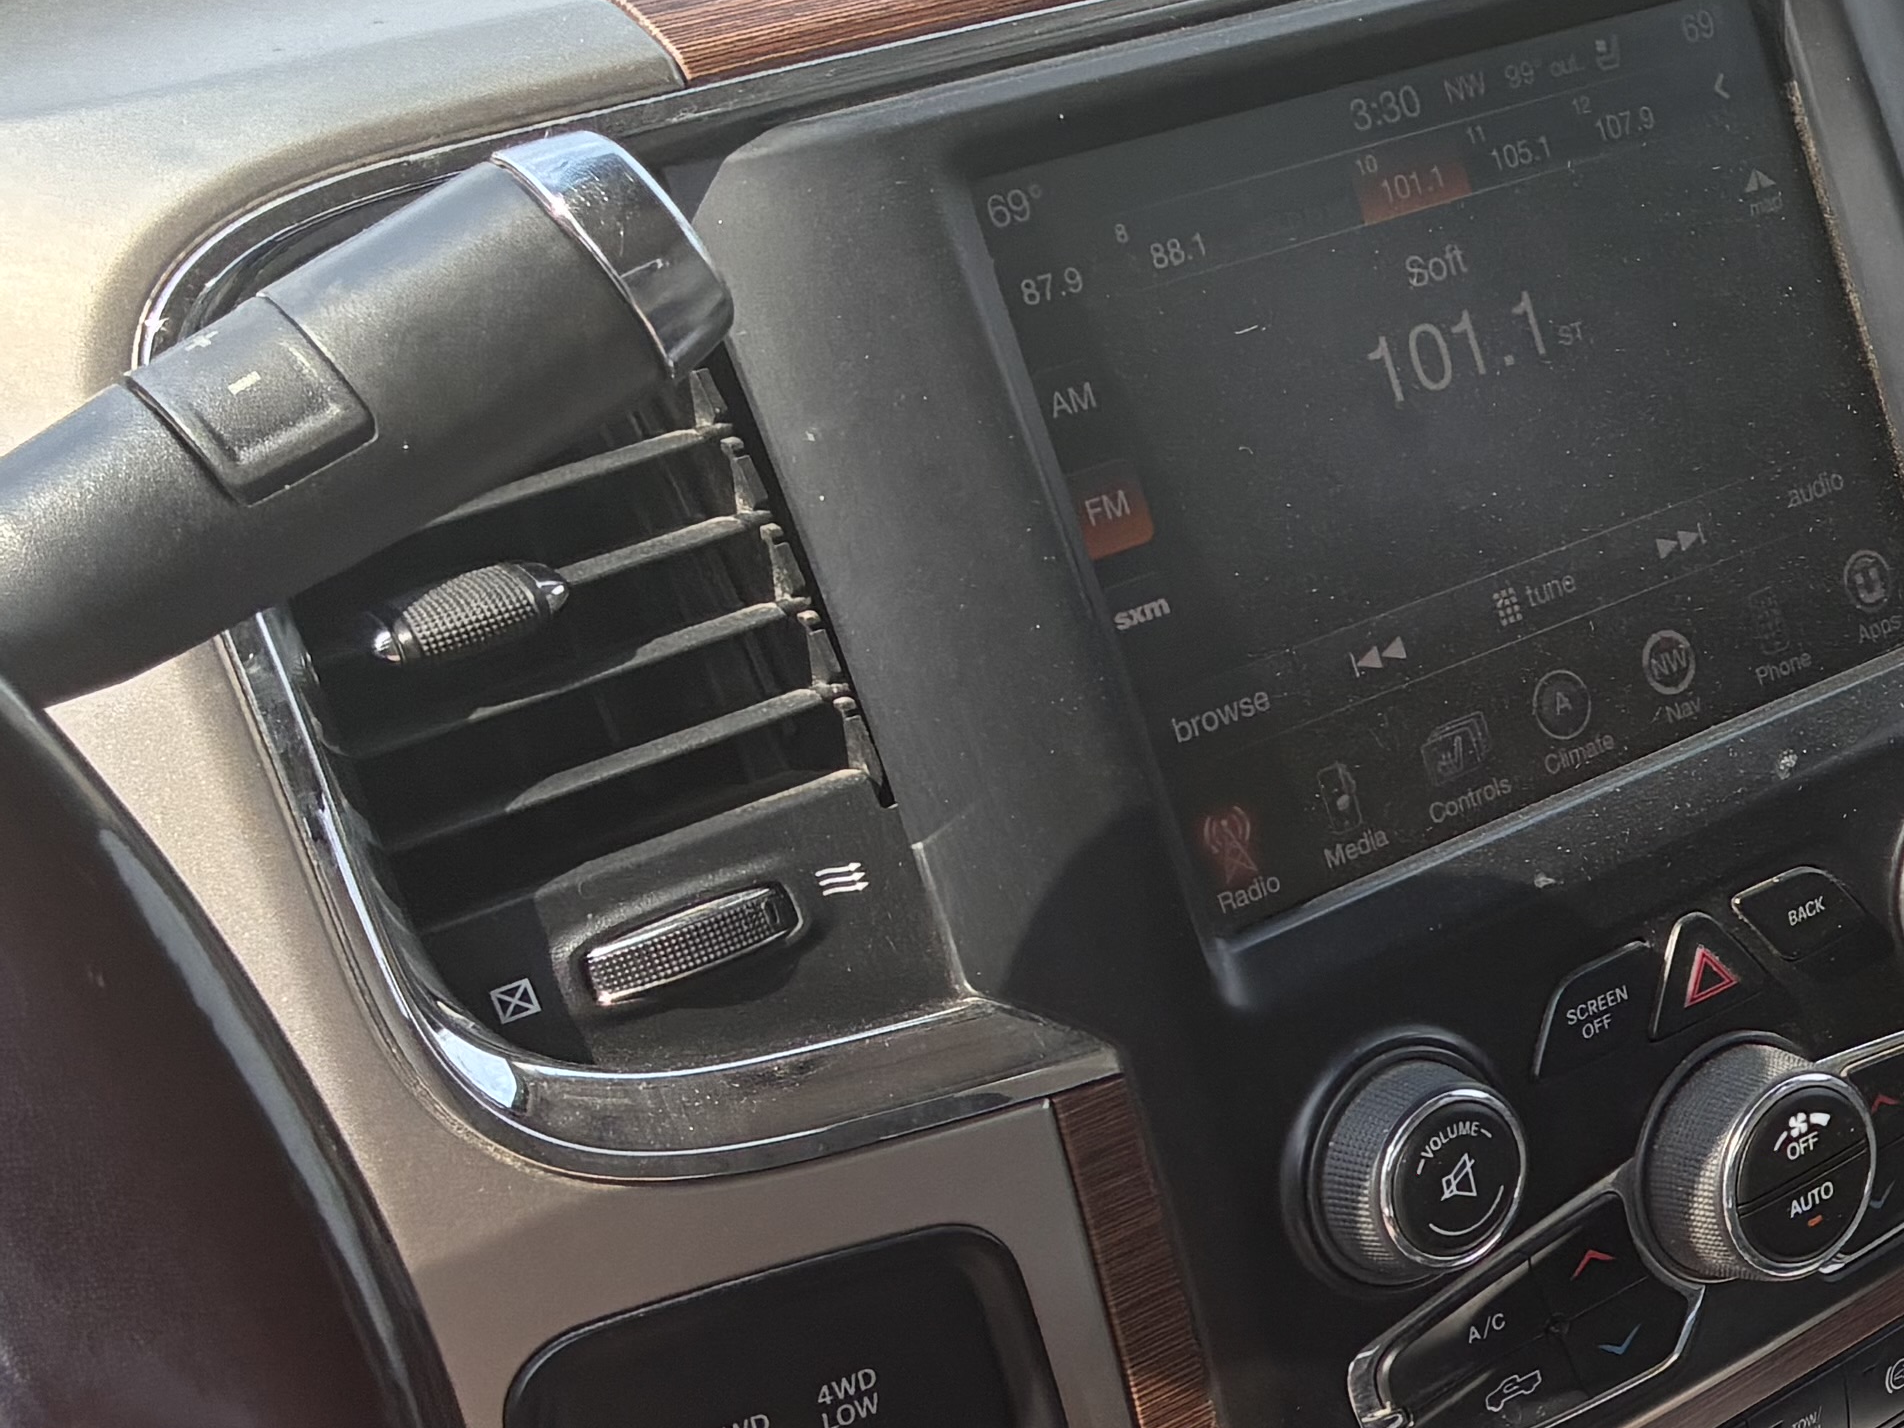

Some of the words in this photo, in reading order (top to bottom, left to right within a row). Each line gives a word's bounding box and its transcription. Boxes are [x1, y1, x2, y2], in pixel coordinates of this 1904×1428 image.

[1350, 85, 1421, 132] 3:30
[1443, 72, 1486, 104] NW
[1572, 95, 1591, 116] 12
[1594, 105, 1655, 141] 107.9
[1356, 154, 1378, 176] 10
[1491, 135, 1552, 172] 105.1
[1381, 165, 1446, 203] 101.1
[1114, 223, 1129, 244] 8
[1150, 232, 1206, 269] 88.1
[1405, 244, 1468, 288] Soft
[1020, 267, 1083, 305] 87.9
[1366, 291, 1547, 403] 101.1
[1052, 381, 1097, 419] AM
[1787, 470, 1845, 508] audio
[1085, 489, 1131, 527] FM
[1524, 573, 1578, 607] tune
[1113, 597, 1172, 631] sxm
[1857, 614, 1902, 647] Apps
[1755, 650, 1814, 686] Phone
[1171, 691, 1271, 743] browse
[1665, 701, 1701, 726] Nav
[1543, 732, 1616, 776] Climate
[1428, 775, 1513, 825] Controls
[1323, 827, 1390, 870] Media
[1217, 873, 1281, 915] Radio
[1787, 895, 1826, 927] BACK
[1566, 985, 1629, 1026] SCREEN
[1582, 1013, 1613, 1040] OFF
[1420, 1121, 1480, 1158] VOLUME
[1786, 1131, 1819, 1161] OFF
[1790, 1180, 1835, 1219] AUTO
[1468, 1312, 1506, 1344] A/C
[816, 1368, 878, 1407] 4WD
